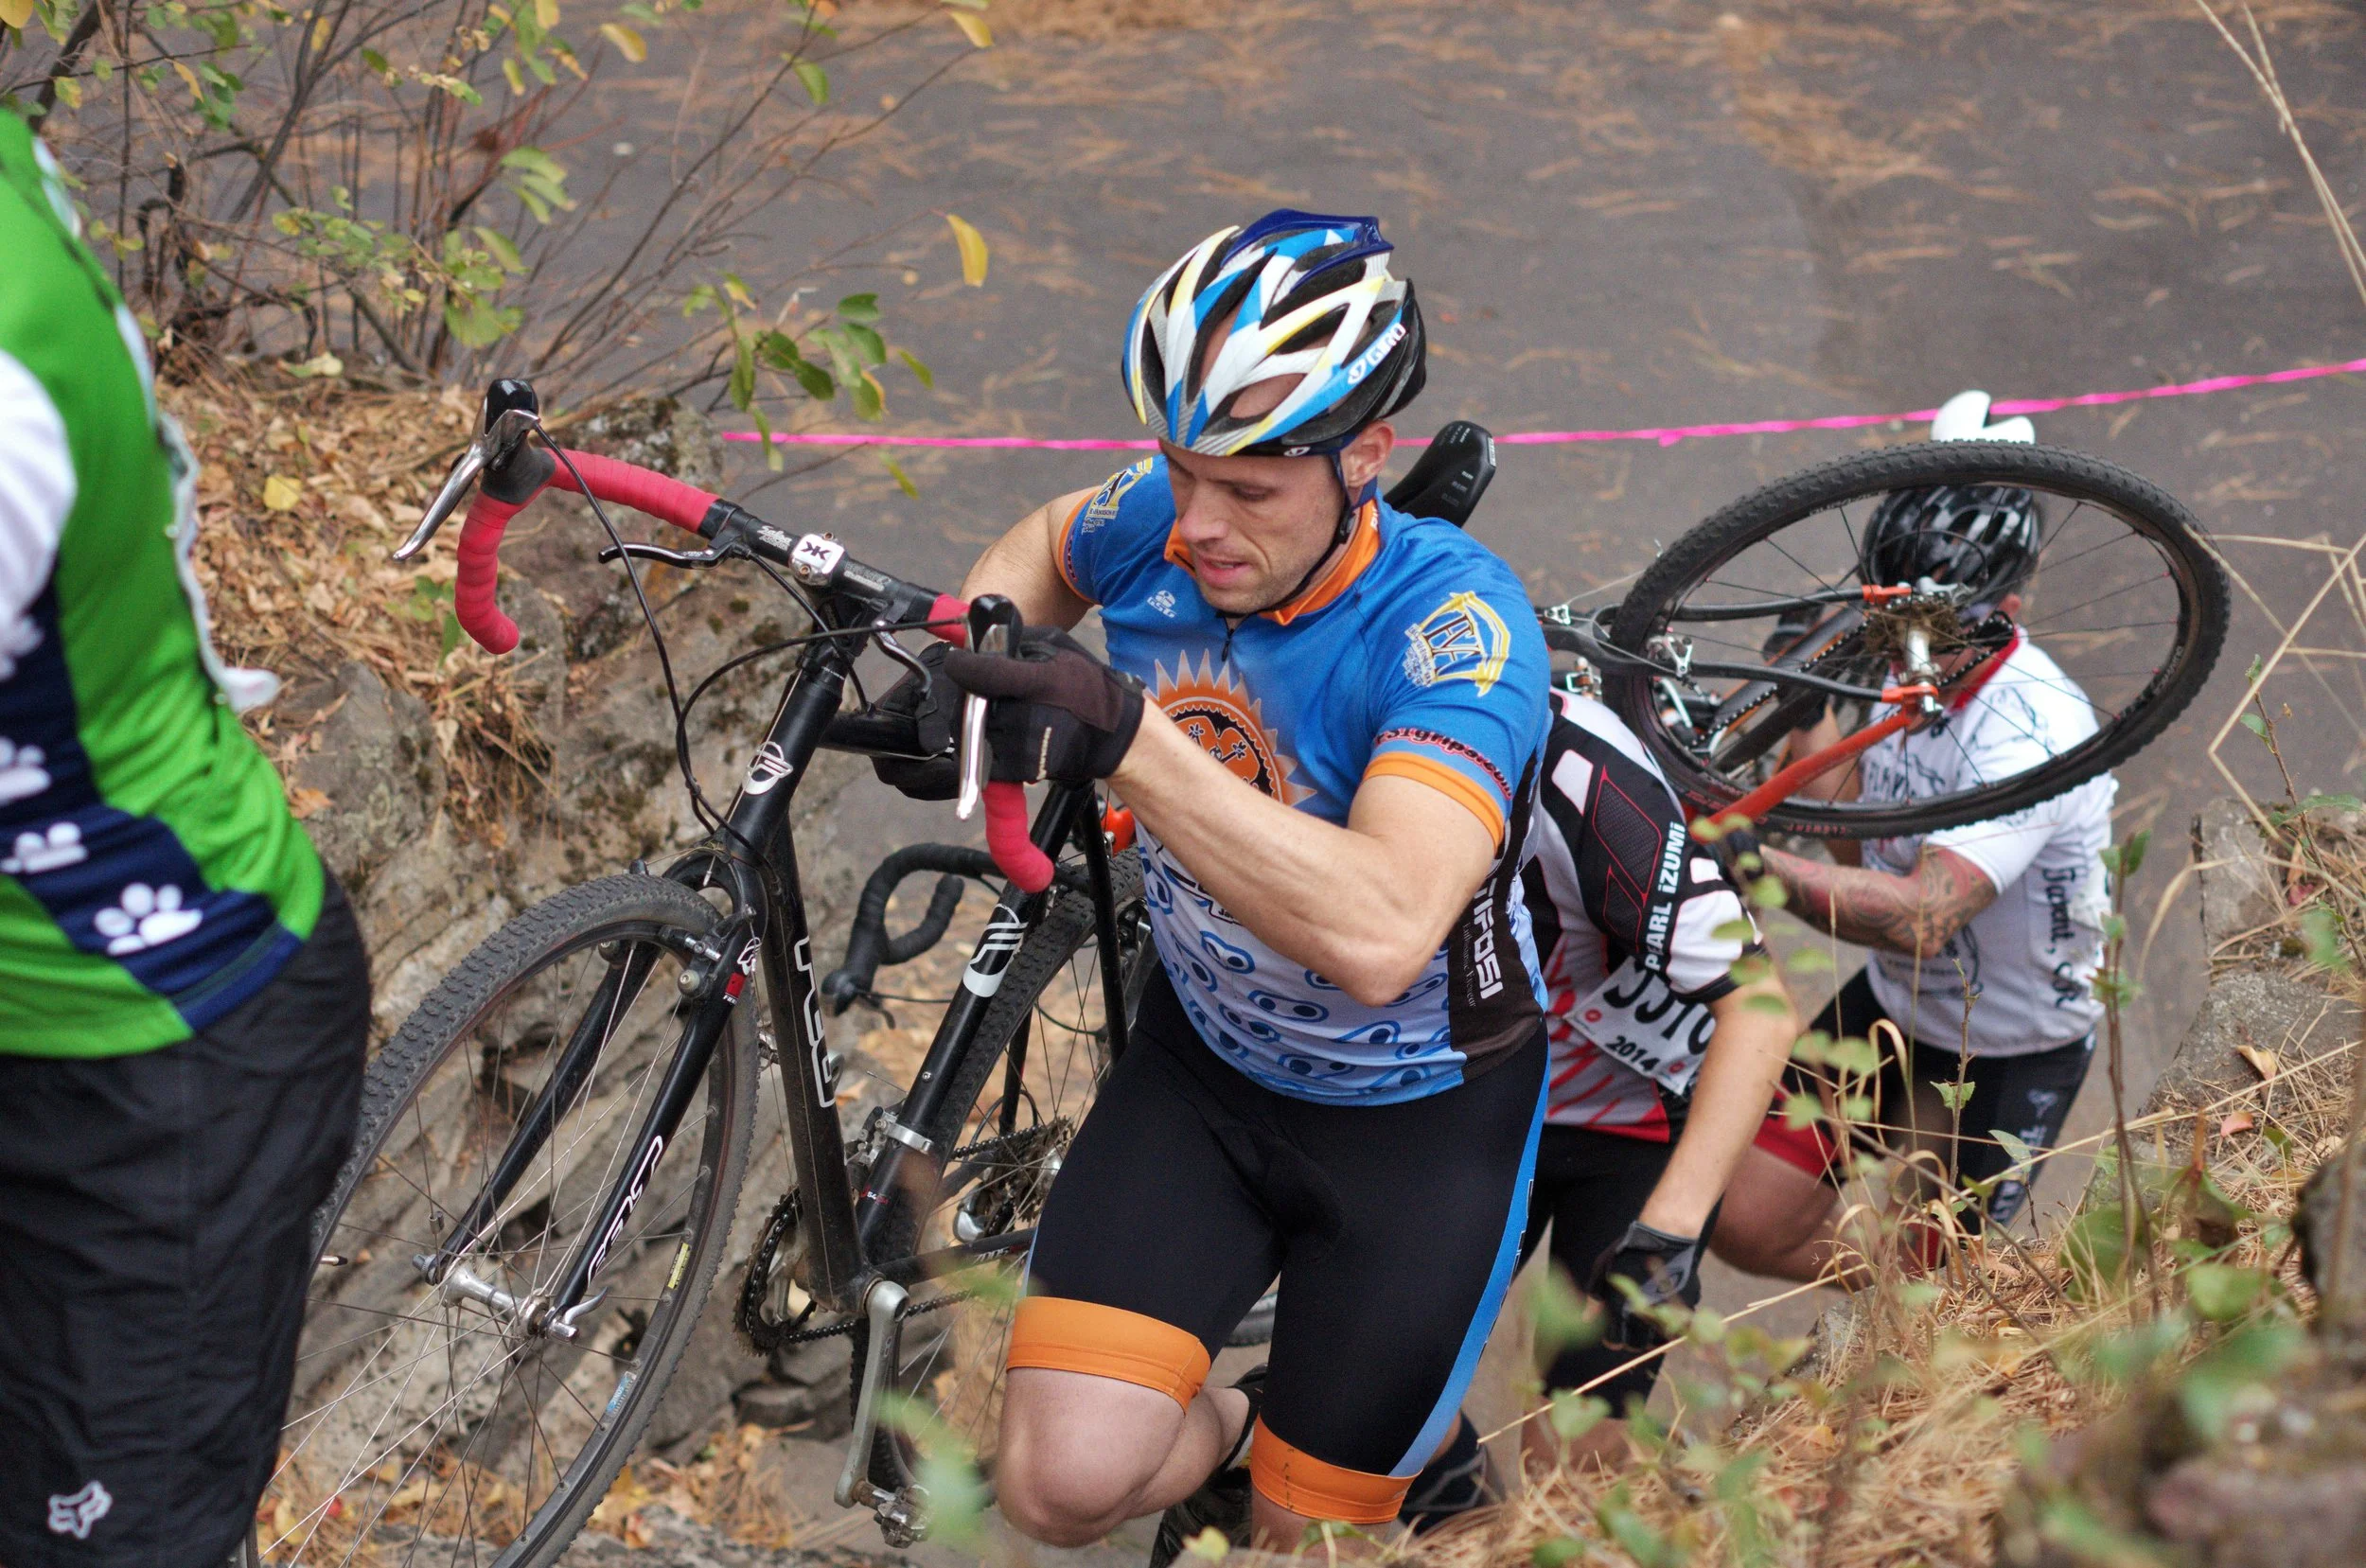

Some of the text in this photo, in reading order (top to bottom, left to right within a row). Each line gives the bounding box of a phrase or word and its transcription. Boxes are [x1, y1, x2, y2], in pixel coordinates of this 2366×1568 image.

[1366, 322, 1406, 365] GIRO
[1146, 597, 1177, 619] GSG
[1474, 877, 1504, 1000] TIFOSI
[1605, 1035, 1661, 1071] 2014
